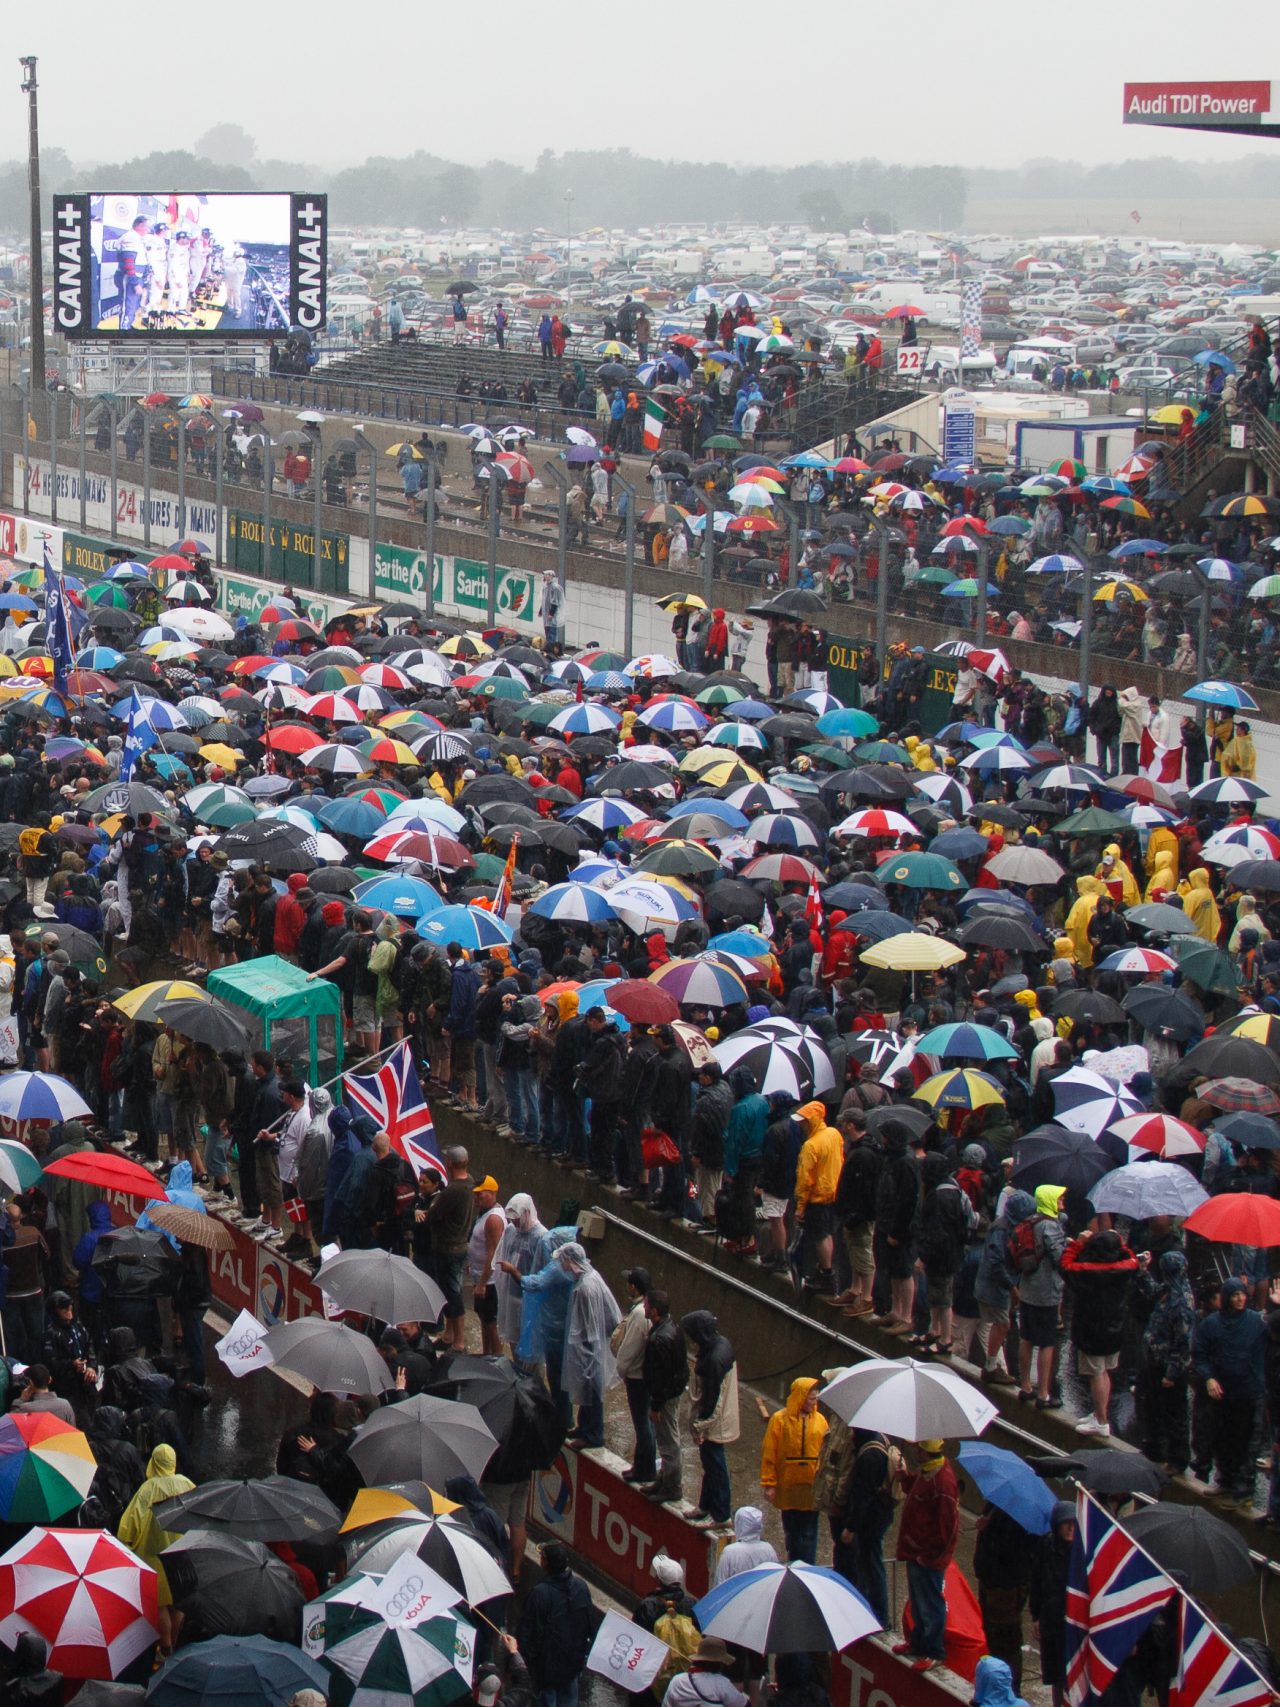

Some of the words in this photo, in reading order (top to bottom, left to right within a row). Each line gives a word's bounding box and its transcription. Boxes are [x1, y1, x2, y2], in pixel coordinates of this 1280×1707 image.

[1128, 94, 1167, 114] Audi
[1200, 94, 1257, 114] Power
[58, 203, 82, 328] CANAL+
[297, 203, 322, 328] CANAL+
[899, 352, 919, 369] 22
[42, 473, 69, 499] HERES
[117, 488, 137, 524] 24
[139, 501, 170, 528] HURES
[76, 547, 105, 573] ROLEX
[375, 553, 409, 584] Sarthe
[456, 570, 489, 600] Sarth
[227, 588, 252, 611] Sarthe
[105, 790, 130, 808] MG
[637, 890, 665, 914] SUZUKI
